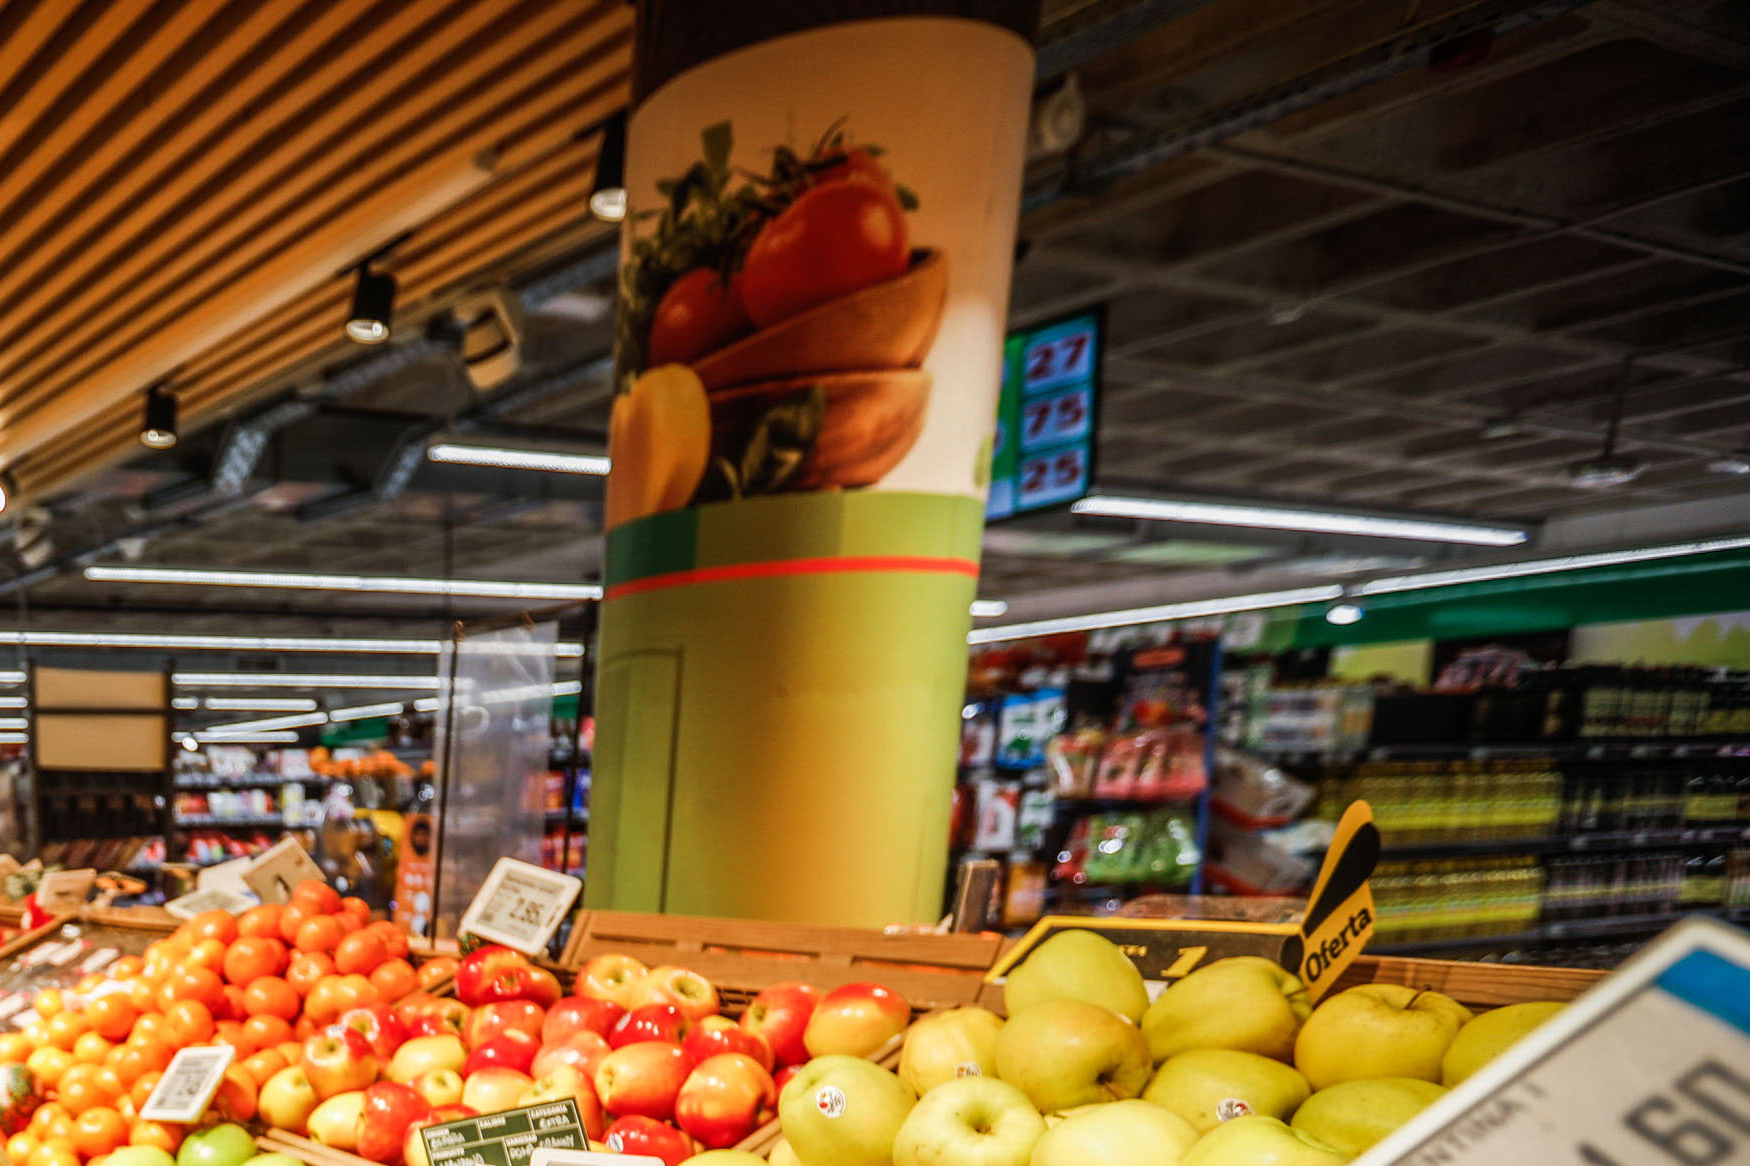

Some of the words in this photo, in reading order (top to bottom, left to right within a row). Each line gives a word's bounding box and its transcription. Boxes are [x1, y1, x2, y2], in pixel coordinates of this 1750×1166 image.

[1027, 332, 1090, 380] 27
[1025, 393, 1086, 437] 75
[1021, 448, 1082, 493] 25
[1304, 906, 1372, 982] Oferta
